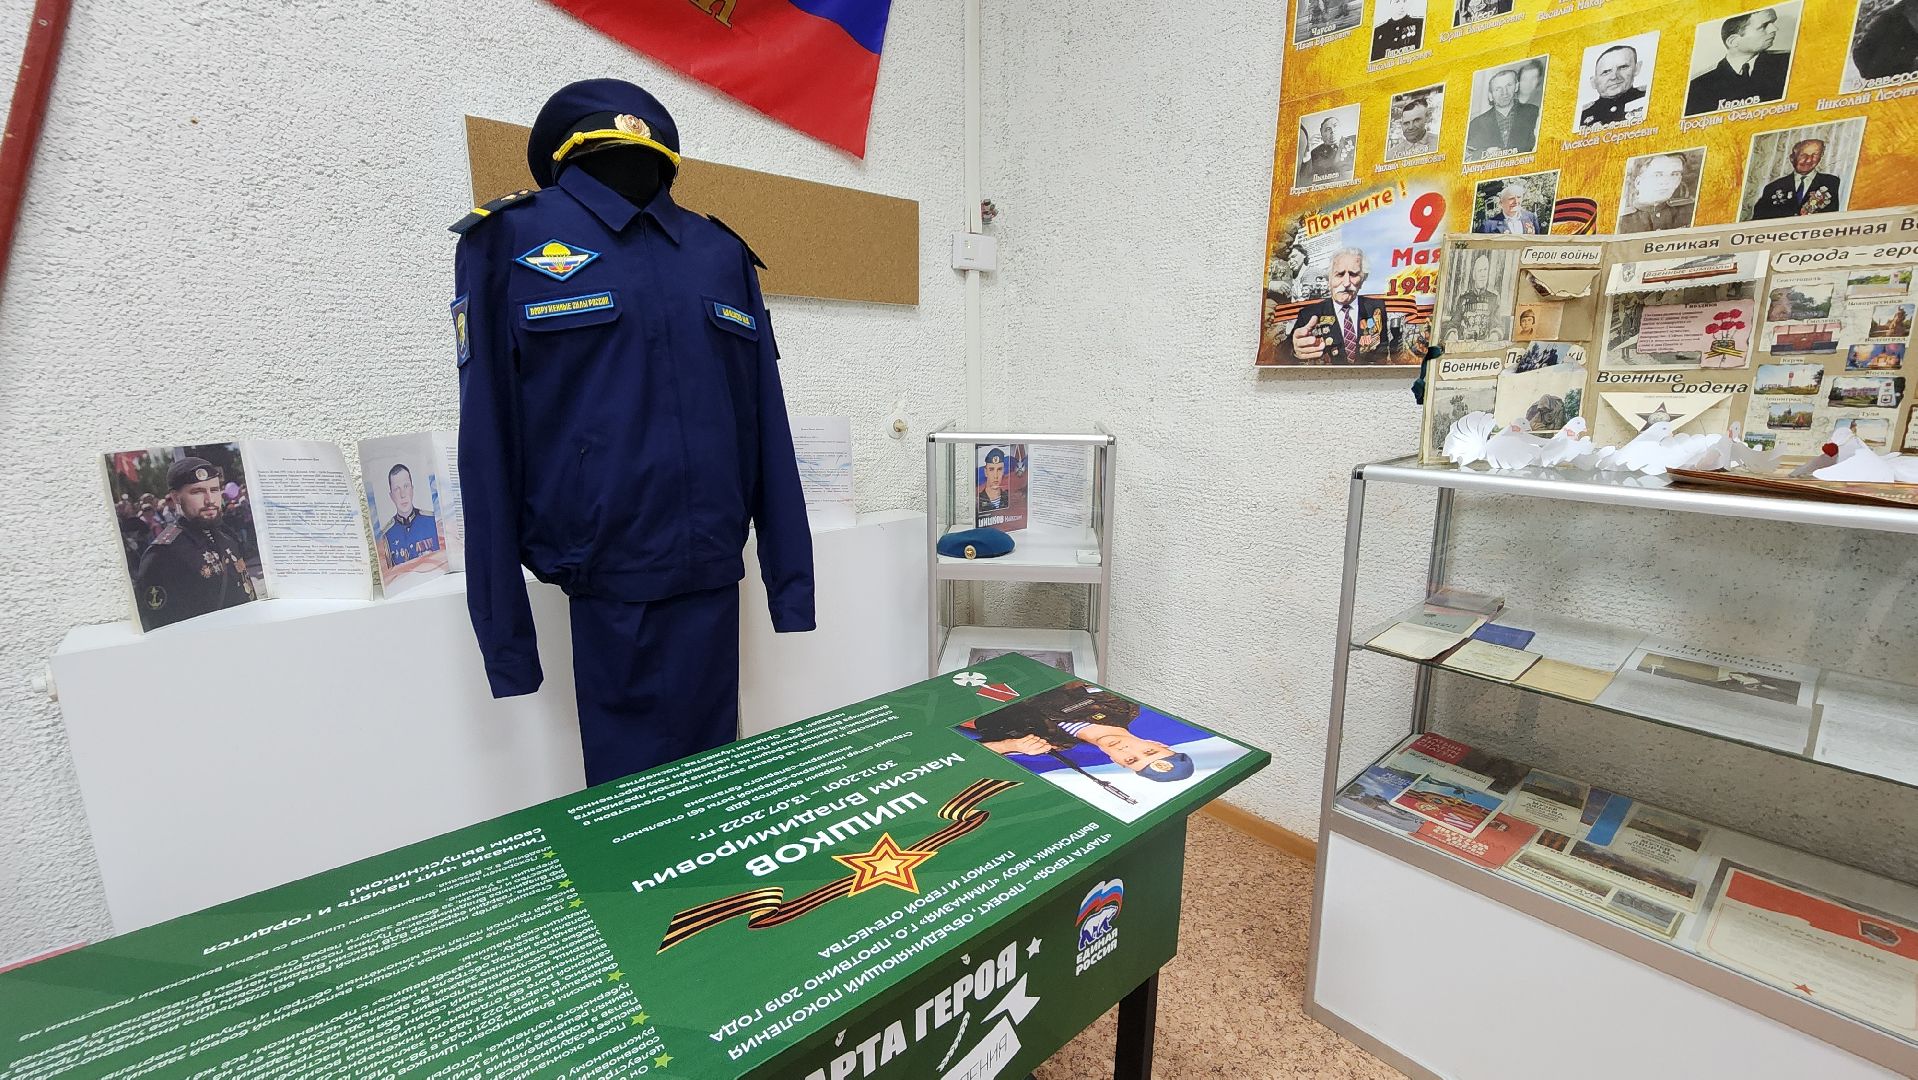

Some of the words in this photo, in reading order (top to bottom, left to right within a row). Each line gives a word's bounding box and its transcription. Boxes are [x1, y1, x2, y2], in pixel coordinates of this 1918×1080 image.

[1717, 95, 1760, 111] Карлов
[1306, 188, 1393, 236] Помните
[1410, 192, 1447, 243] 9
[1523, 248, 1557, 261] Герои
[1560, 247, 1599, 260] войны
[1643, 237, 1720, 254] Великая
[1729, 222, 1888, 246] Отечественная
[1776, 249, 1849, 265] Города
[1441, 361, 1501, 372] Военные
[1597, 371, 1684, 384] Военные
[1671, 381, 1749, 394] Ордена
[821, 759, 898, 792] 30.12.2001
[867, 752, 965, 794] Максим
[718, 794, 810, 832] 13.07.2022
[489, 827, 541, 848] своим
[631, 791, 868, 892] Владимирович
[690, 828, 716, 840] гг.
[745, 791, 928, 876] ШИШКОВ
[1033, 822, 1099, 860] ВЫПУСКНИК
[1071, 833, 1111, 856] «ПАРТА
[461, 834, 546, 867] Гимназия
[960, 850, 1015, 883] ПАТРИОТ
[350, 845, 484, 896] выпускником!
[415, 866, 456, 882] чтит
[947, 879, 960, 889] И
[1002, 857, 1036, 880] МБОУ
[1033, 855, 1075, 880] ГЕРОЯ»
[337, 879, 409, 907] память
[903, 886, 948, 914] ГЕРОЙ
[919, 878, 999, 924] «ГИМНАЗИЯ»
[971, 882, 1026, 915] ПРОЕКТ,
[318, 906, 331, 915] и
[203, 913, 311, 954] гордится
[817, 910, 903, 957] ОТЕЧЕСТВА
[890, 922, 918, 938] Г.О.
[1076, 927, 1118, 964] ЕДИНАЯ
[804, 937, 891, 989] ПРОТВИНО
[842, 913, 973, 993] ОБЪЕДИНЯЮЩИЙ
[1075, 938, 1118, 976] РОССИЯ
[765, 986, 803, 1011] 2019
[915, 941, 1017, 1042] ГЕРОЯ
[709, 1008, 762, 1041] ГОДА
[727, 988, 842, 1060] ПОКОЛЕНИЯ
